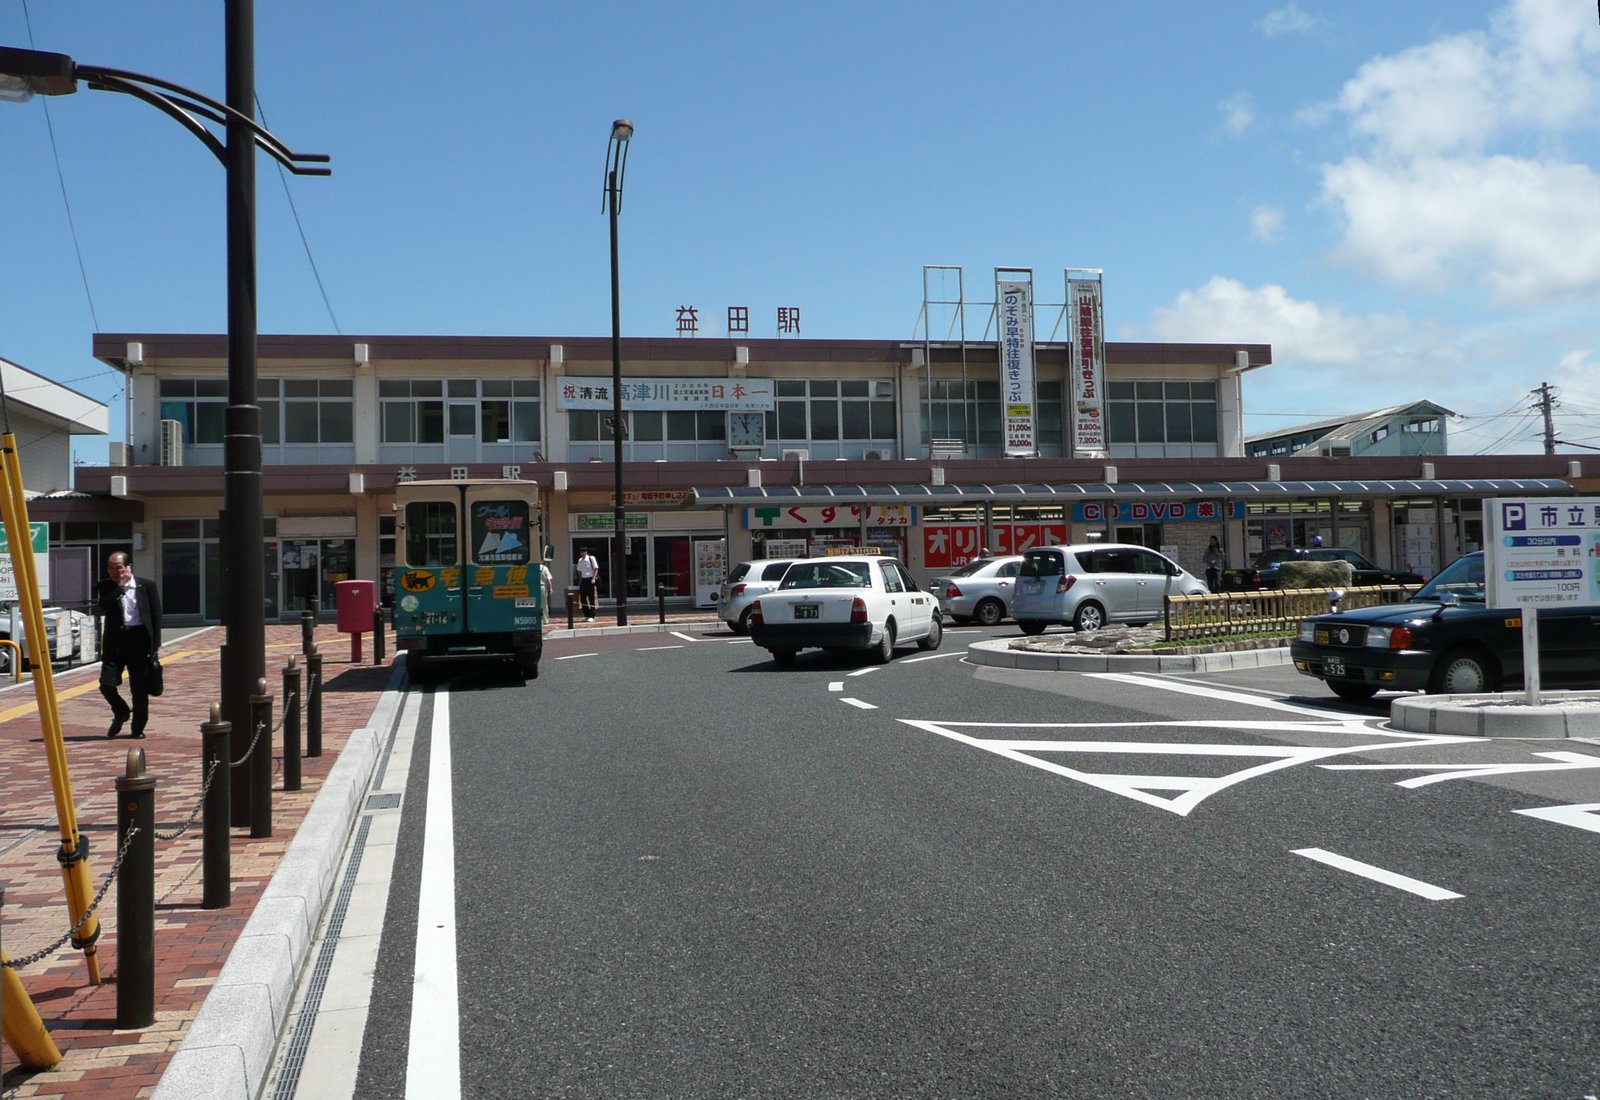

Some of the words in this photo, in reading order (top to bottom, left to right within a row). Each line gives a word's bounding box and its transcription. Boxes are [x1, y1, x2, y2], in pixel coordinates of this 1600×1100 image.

[675, 305, 801, 333] 益田駅
[711, 384, 769, 400] 日本一
[877, 517, 908, 525] タナカ
[1505, 505, 1524, 528] P
[928, 527, 1061, 555] オリエント
[1557, 582, 1580, 591] 100円
